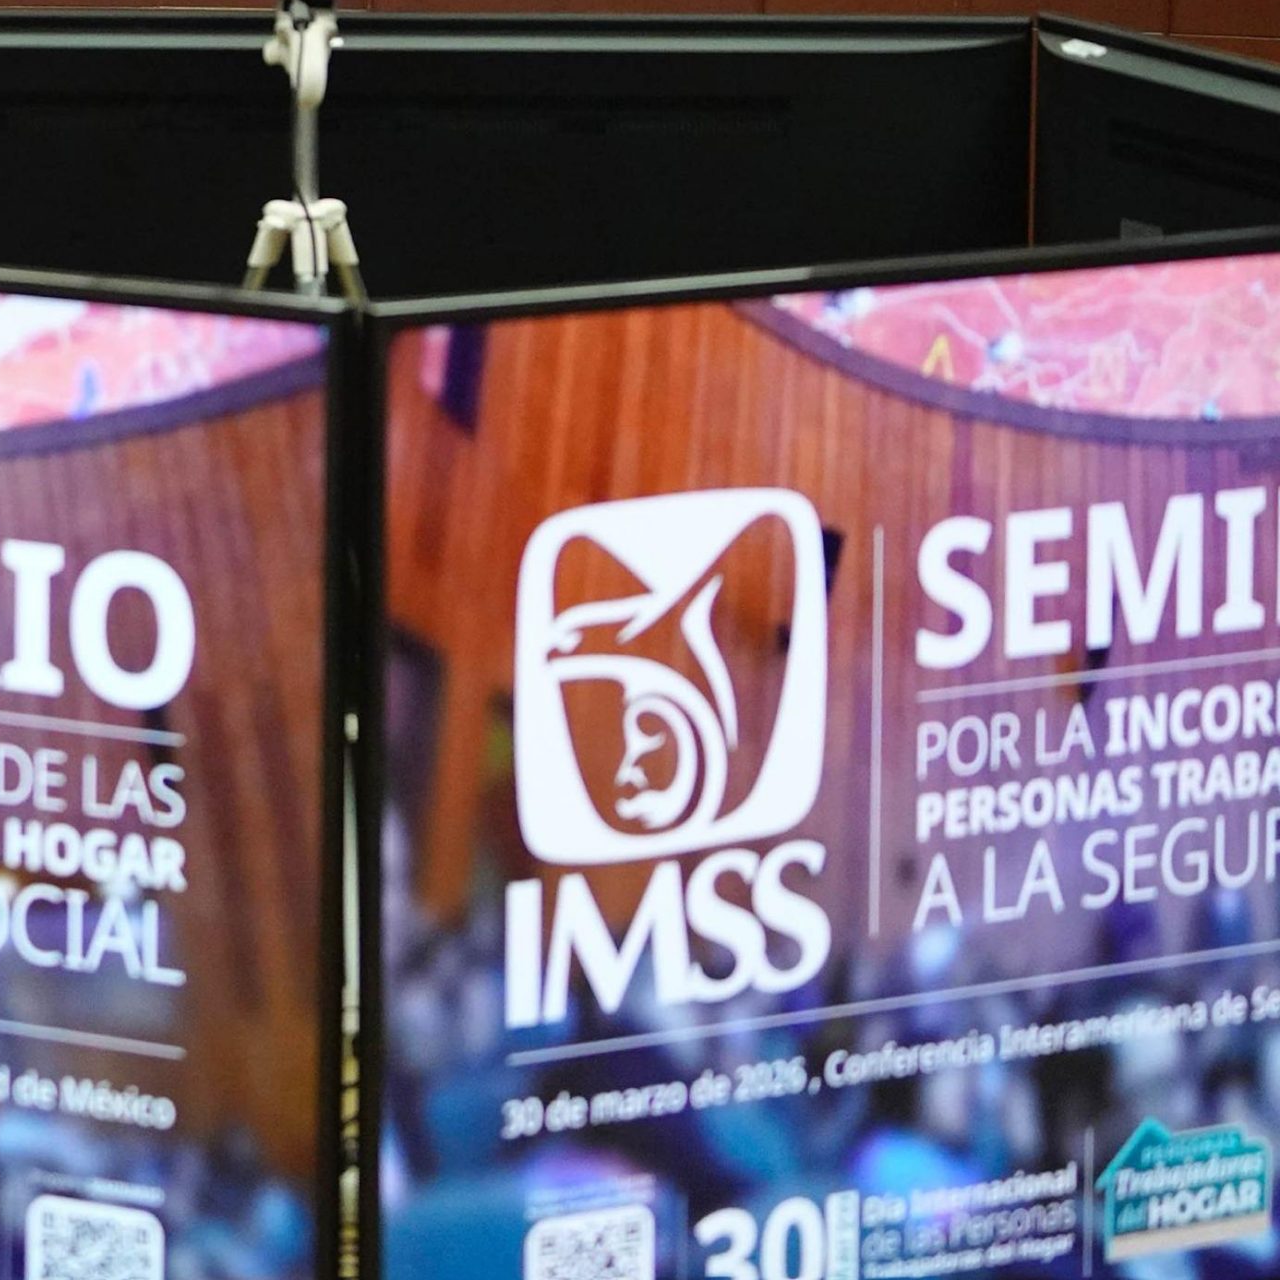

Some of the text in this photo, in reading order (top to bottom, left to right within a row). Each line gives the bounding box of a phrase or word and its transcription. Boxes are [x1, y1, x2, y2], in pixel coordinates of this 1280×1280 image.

[915, 486, 1280, 669] SEMI
[916, 678, 1280, 782] POR LA INCOR
[82, 755, 187, 827] LAS
[916, 747, 1280, 843] PERSONAS TRABA
[3, 817, 187, 892] HOGAR
[912, 852, 963, 932] A
[984, 837, 1065, 924] LA
[505, 839, 832, 1029] IMSS
[12, 1068, 58, 1110] de
[59, 1076, 177, 1129] México
[500, 1096, 544, 1140] 30
[545, 1090, 589, 1132] de
[590, 1081, 687, 1126] marzo
[689, 1068, 732, 1109] de
[823, 1028, 995, 1088] Conferencia
[999, 999, 1207, 1060] Interamericana
[1211, 990, 1248, 1027] de
[909, 1160, 1078, 1218] Internacional
[948, 1199, 1077, 1249] Personas
[1147, 1179, 1261, 1229] HOGAR
